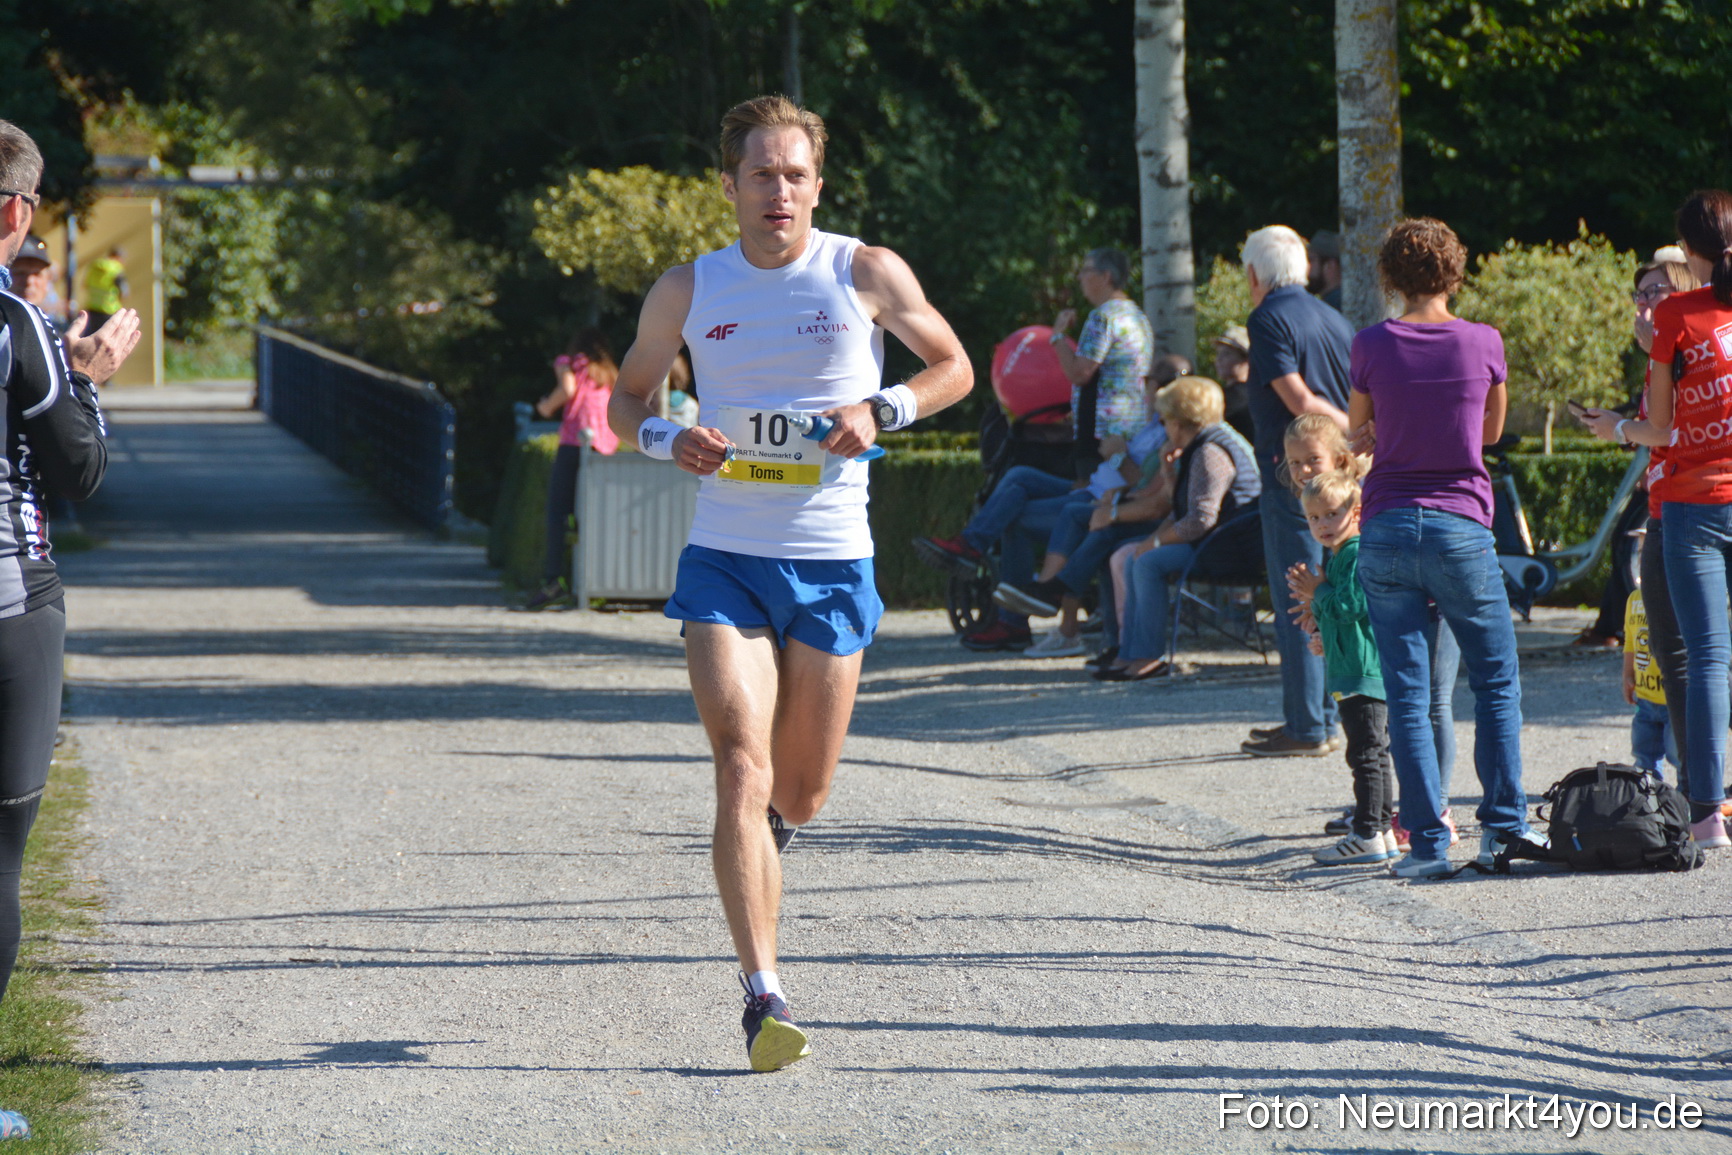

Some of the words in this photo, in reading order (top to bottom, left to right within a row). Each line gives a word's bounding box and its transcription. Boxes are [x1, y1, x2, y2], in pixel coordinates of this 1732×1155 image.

[705, 323, 738, 340] 4F
[797, 323, 849, 335] LATVIJA
[749, 412, 788, 447] 10
[736, 448, 757, 457] PARTL
[758, 450, 792, 459] Neumarkt
[748, 464, 784, 481] Toms
